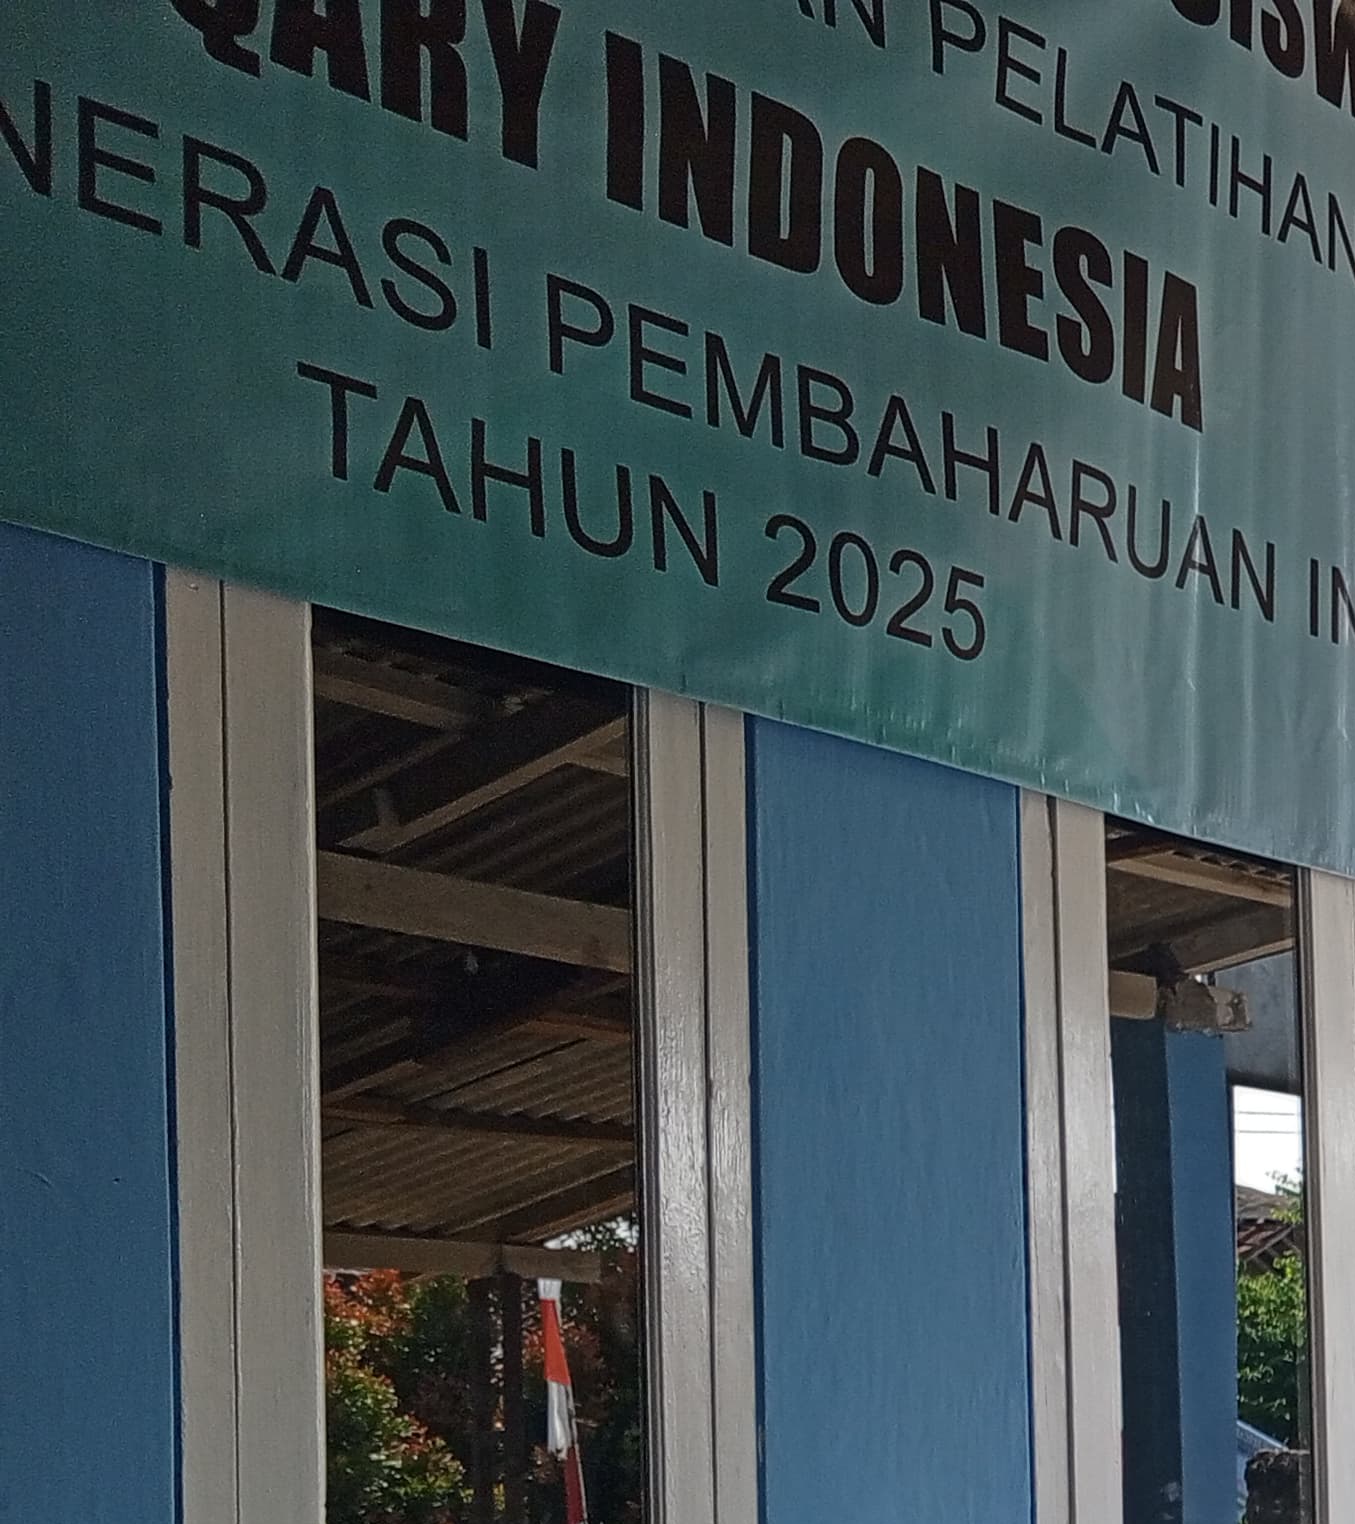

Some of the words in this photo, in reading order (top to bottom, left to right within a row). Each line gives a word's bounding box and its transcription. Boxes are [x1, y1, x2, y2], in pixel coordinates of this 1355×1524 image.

[604, 29, 1204, 434] INDONESIA
[296, 361, 719, 588] TAHUN
[764, 514, 986, 661] 2025
[546, 273, 1276, 625] PEMBAHARUAN
